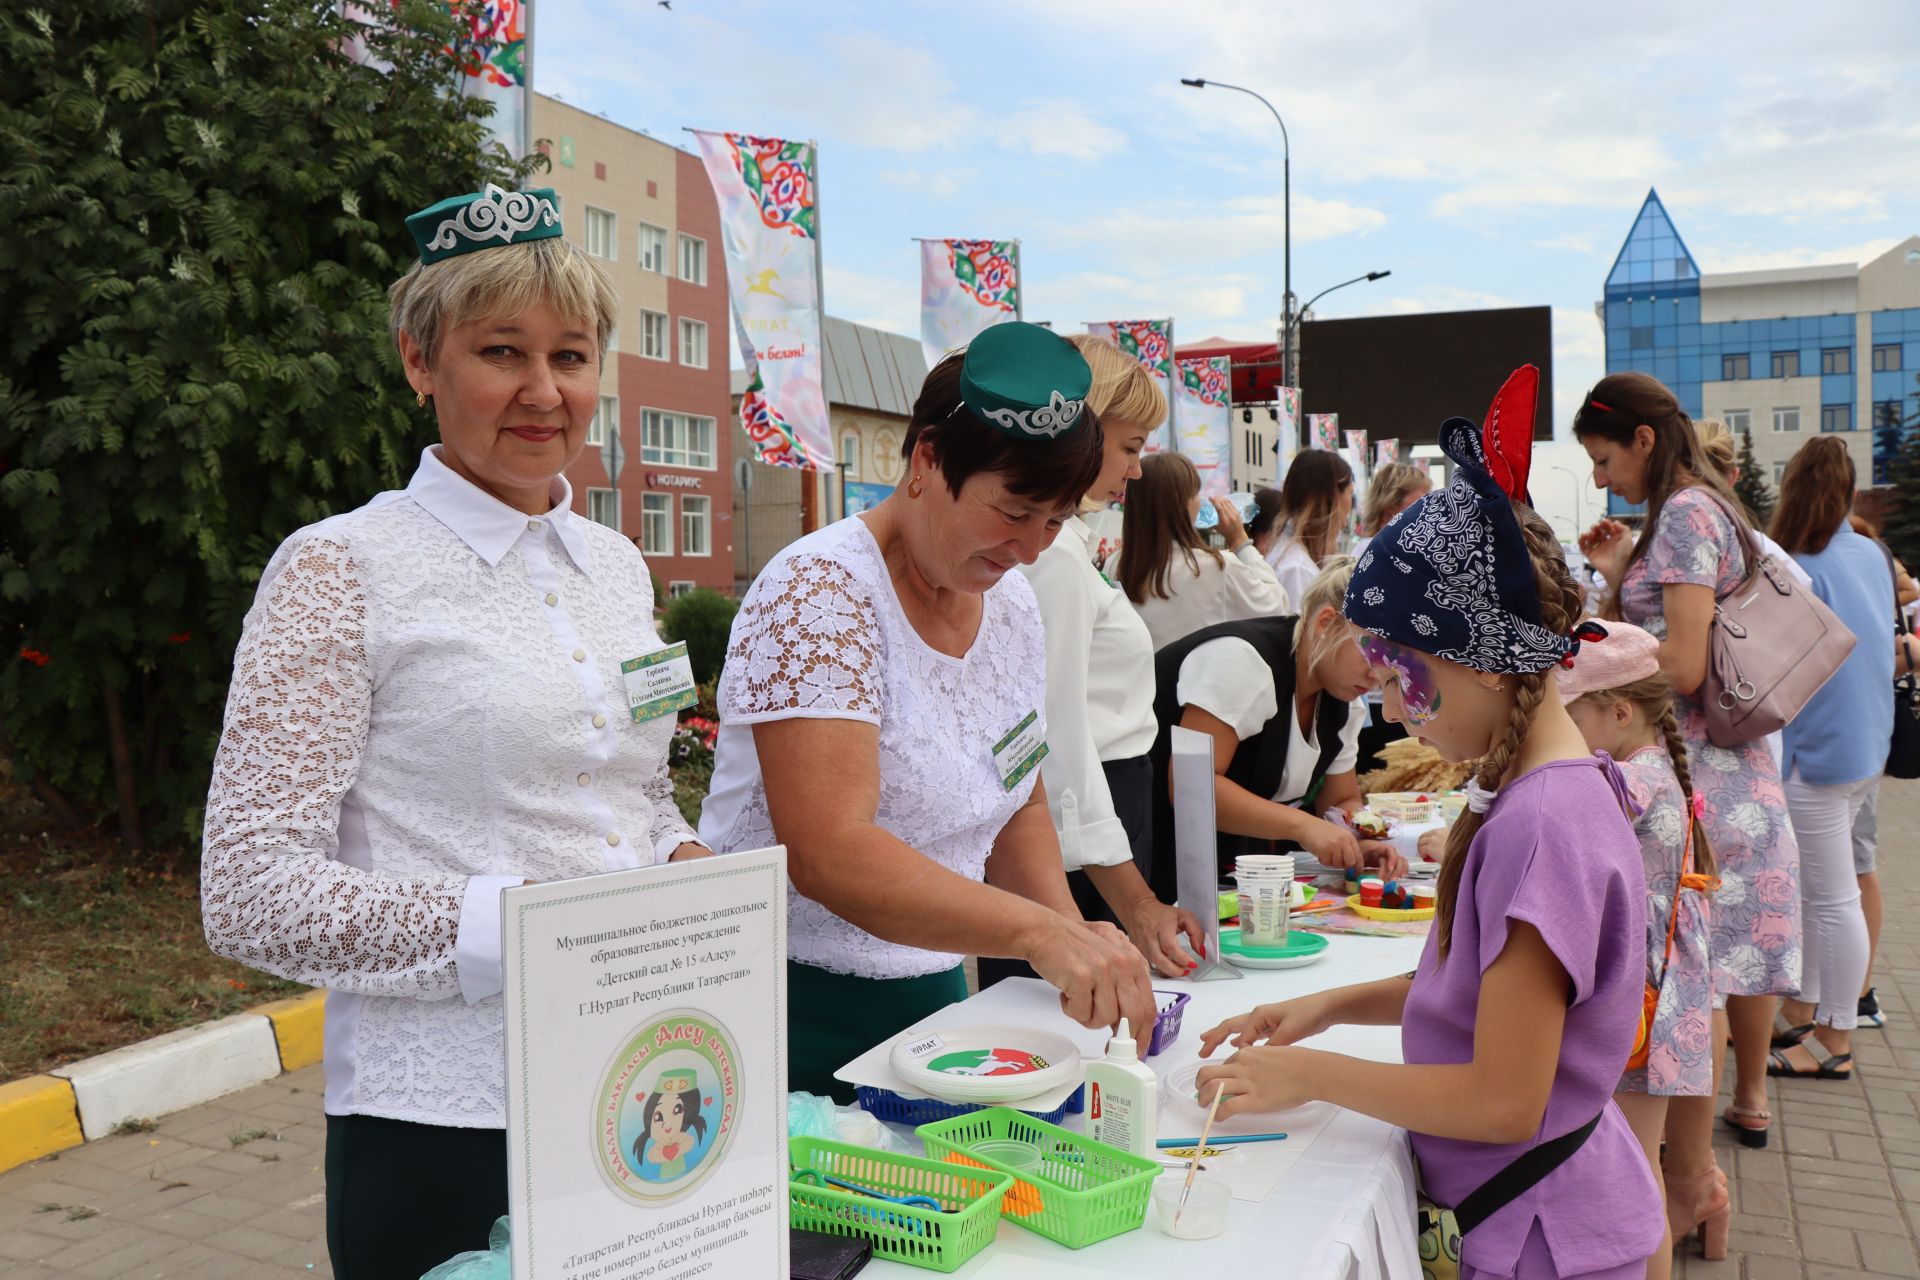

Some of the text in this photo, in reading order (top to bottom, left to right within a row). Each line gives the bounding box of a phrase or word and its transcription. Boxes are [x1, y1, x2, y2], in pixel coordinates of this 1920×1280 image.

[656, 474, 702, 489] НОТАРИУС
[556, 901, 768, 951] Муниципальное бюджетное дошкольное
[590, 924, 741, 964] образовательное учреждение
[596, 948, 736, 988] «Детский сад № 15 «Алсу»
[579, 967, 751, 1016] Г.Нурлат Республики Татарстан»
[910, 1040, 937, 1055] НУРЛАТ
[608, 1045, 650, 1111] БАКЧАСЫ
[719, 1103, 733, 1135] САД
[562, 1184, 773, 1270] «Татарстан Республикасы Нурлат шәһәре
[604, 1249, 651, 1275] номерлы
[654, 1233, 691, 1254] «Алсу»
[693, 1215, 732, 1239] балалар
[733, 1201, 772, 1223] бакчасы
[657, 1254, 688, 1272] белем
[690, 1228, 749, 1258] муниципаль
